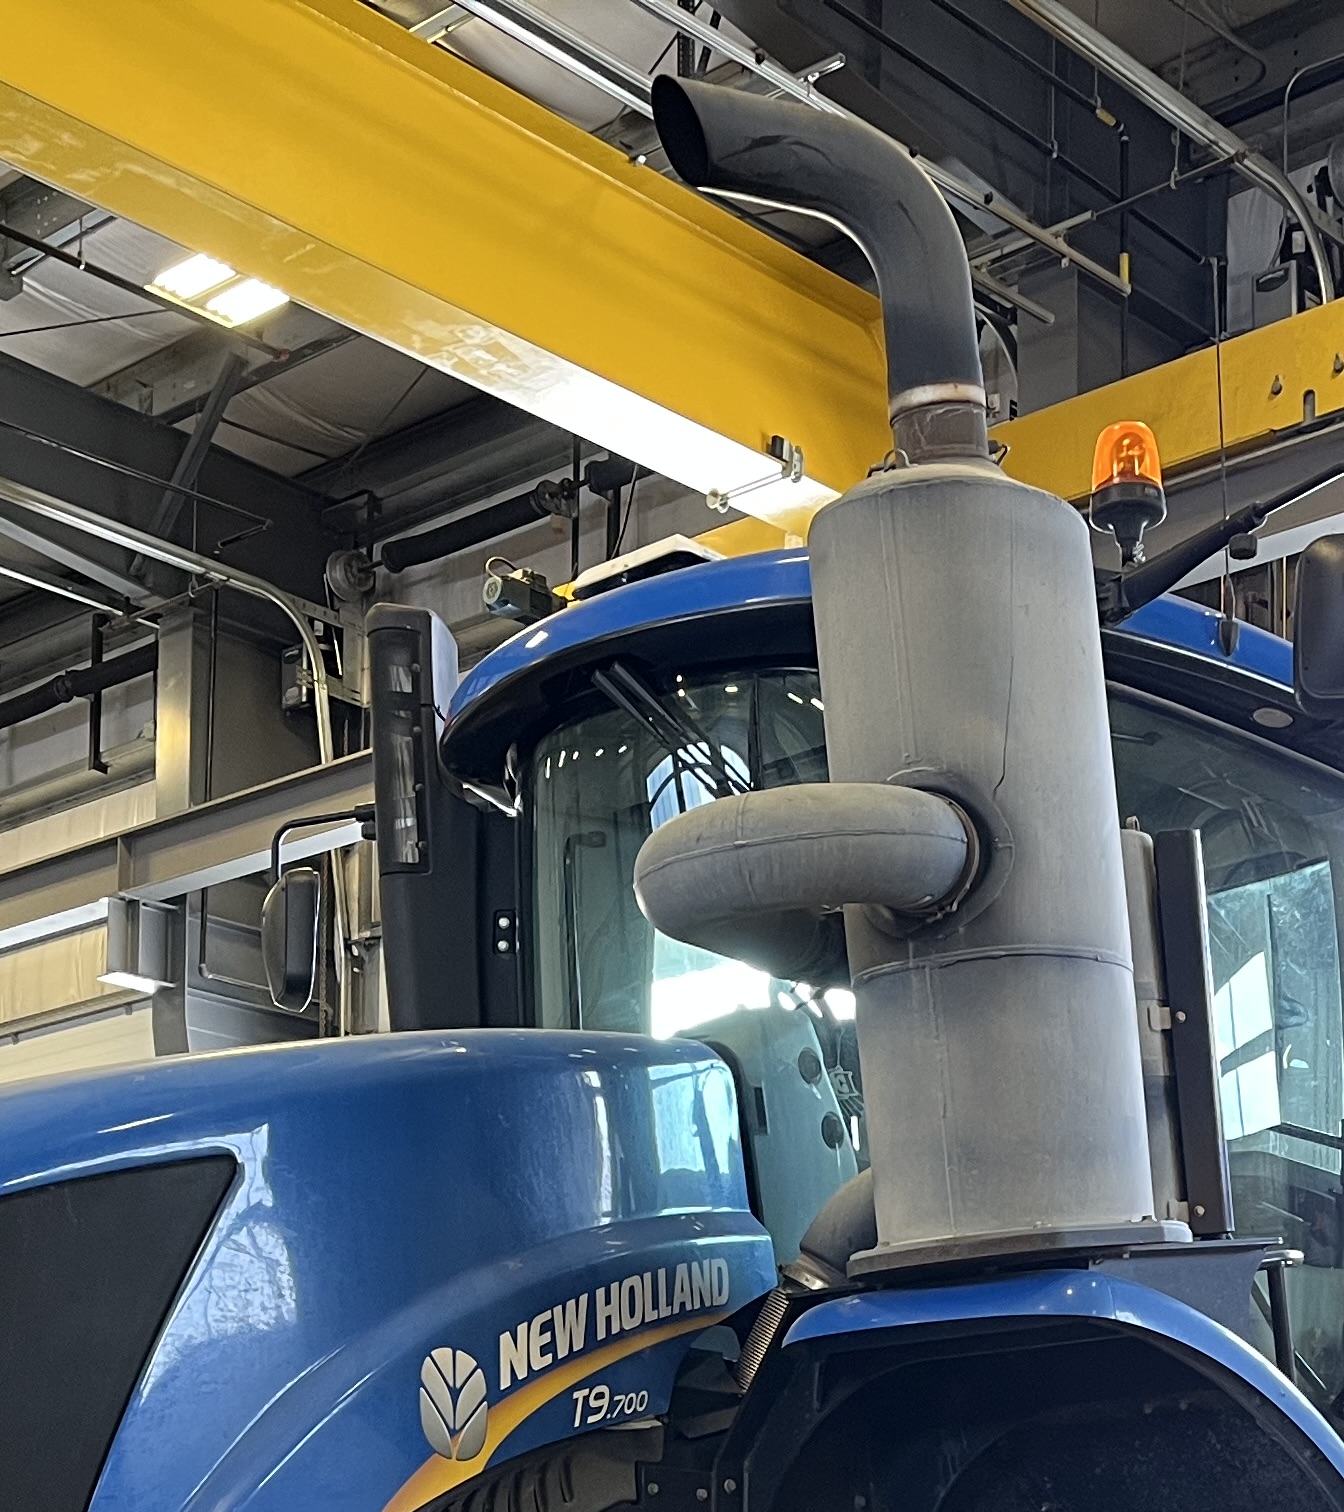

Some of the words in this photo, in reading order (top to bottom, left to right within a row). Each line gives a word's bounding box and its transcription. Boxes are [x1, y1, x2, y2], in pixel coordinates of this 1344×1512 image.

[499, 1292, 588, 1391] NEW
[597, 1258, 729, 1340] HOLLAND
[572, 1384, 649, 1428] T9.700
